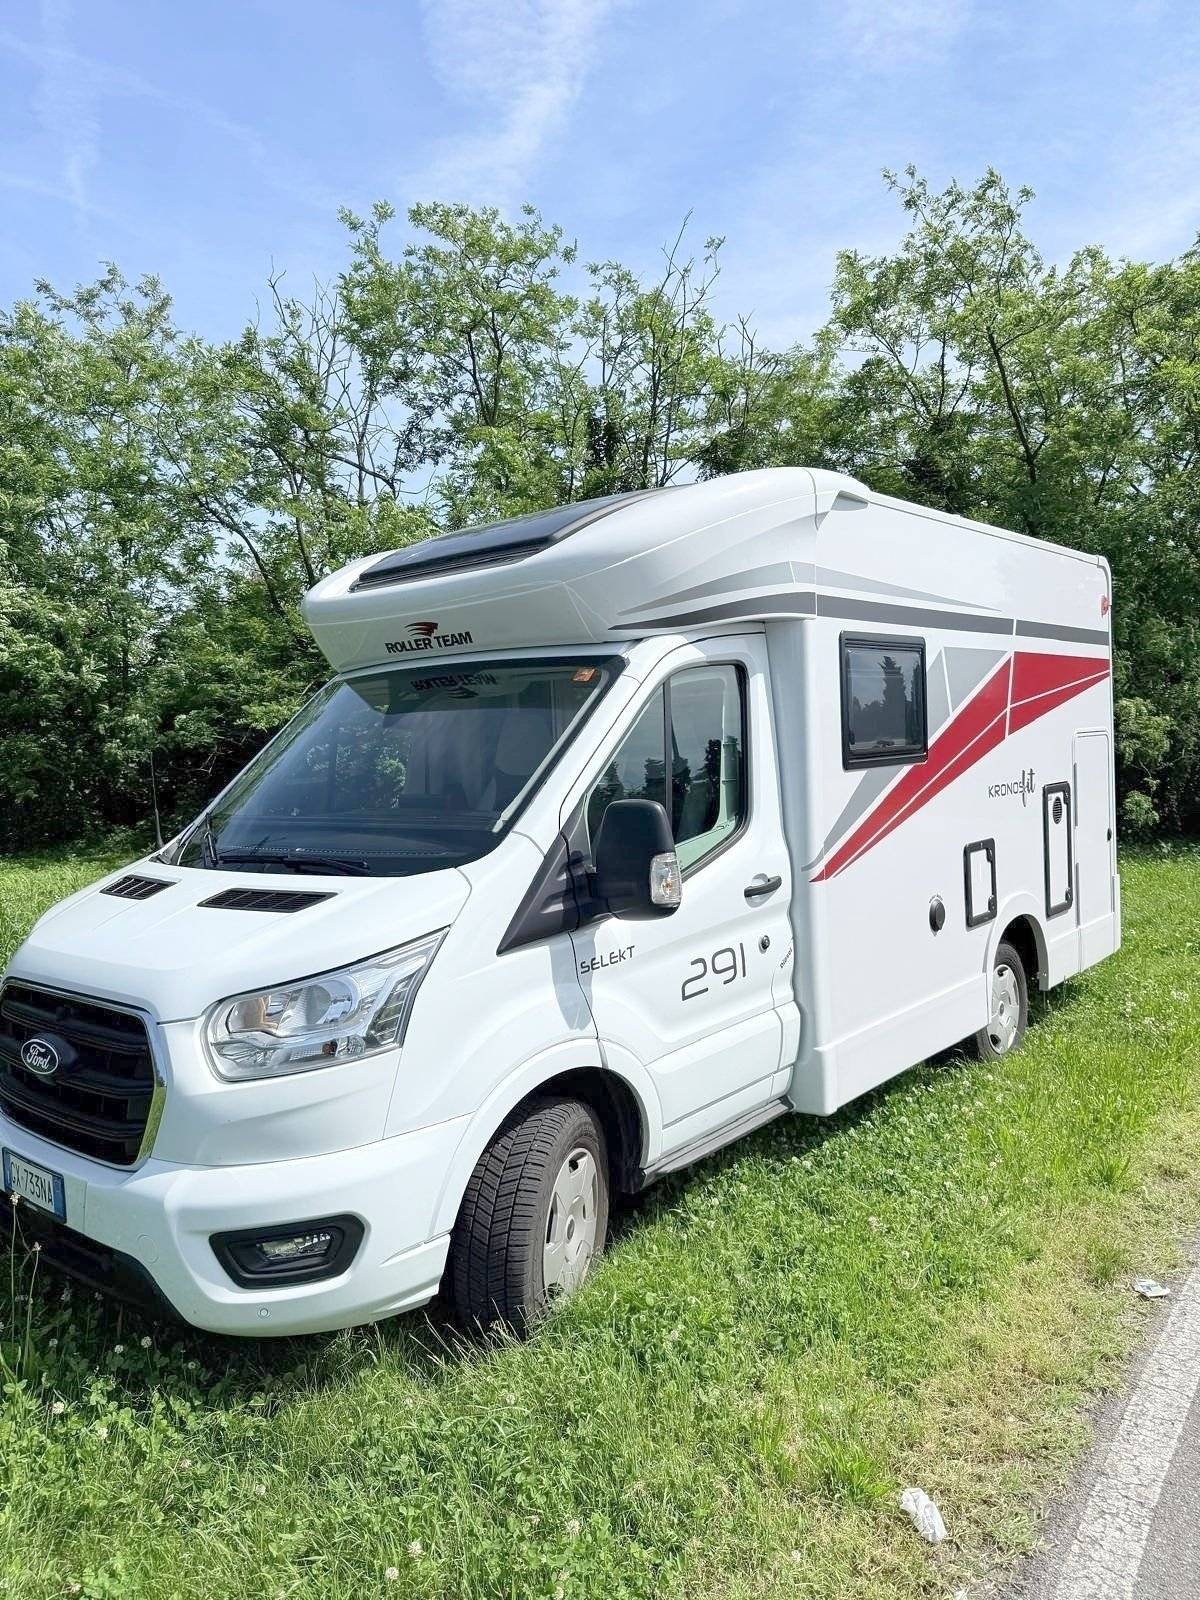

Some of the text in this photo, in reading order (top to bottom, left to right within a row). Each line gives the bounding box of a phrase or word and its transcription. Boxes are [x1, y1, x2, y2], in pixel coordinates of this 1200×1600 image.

[384, 631, 473, 654] ROLLER TEAM
[580, 945, 635, 974] SELEKT
[681, 942, 746, 1001] 291
[26, 1044, 51, 1069] Ford
